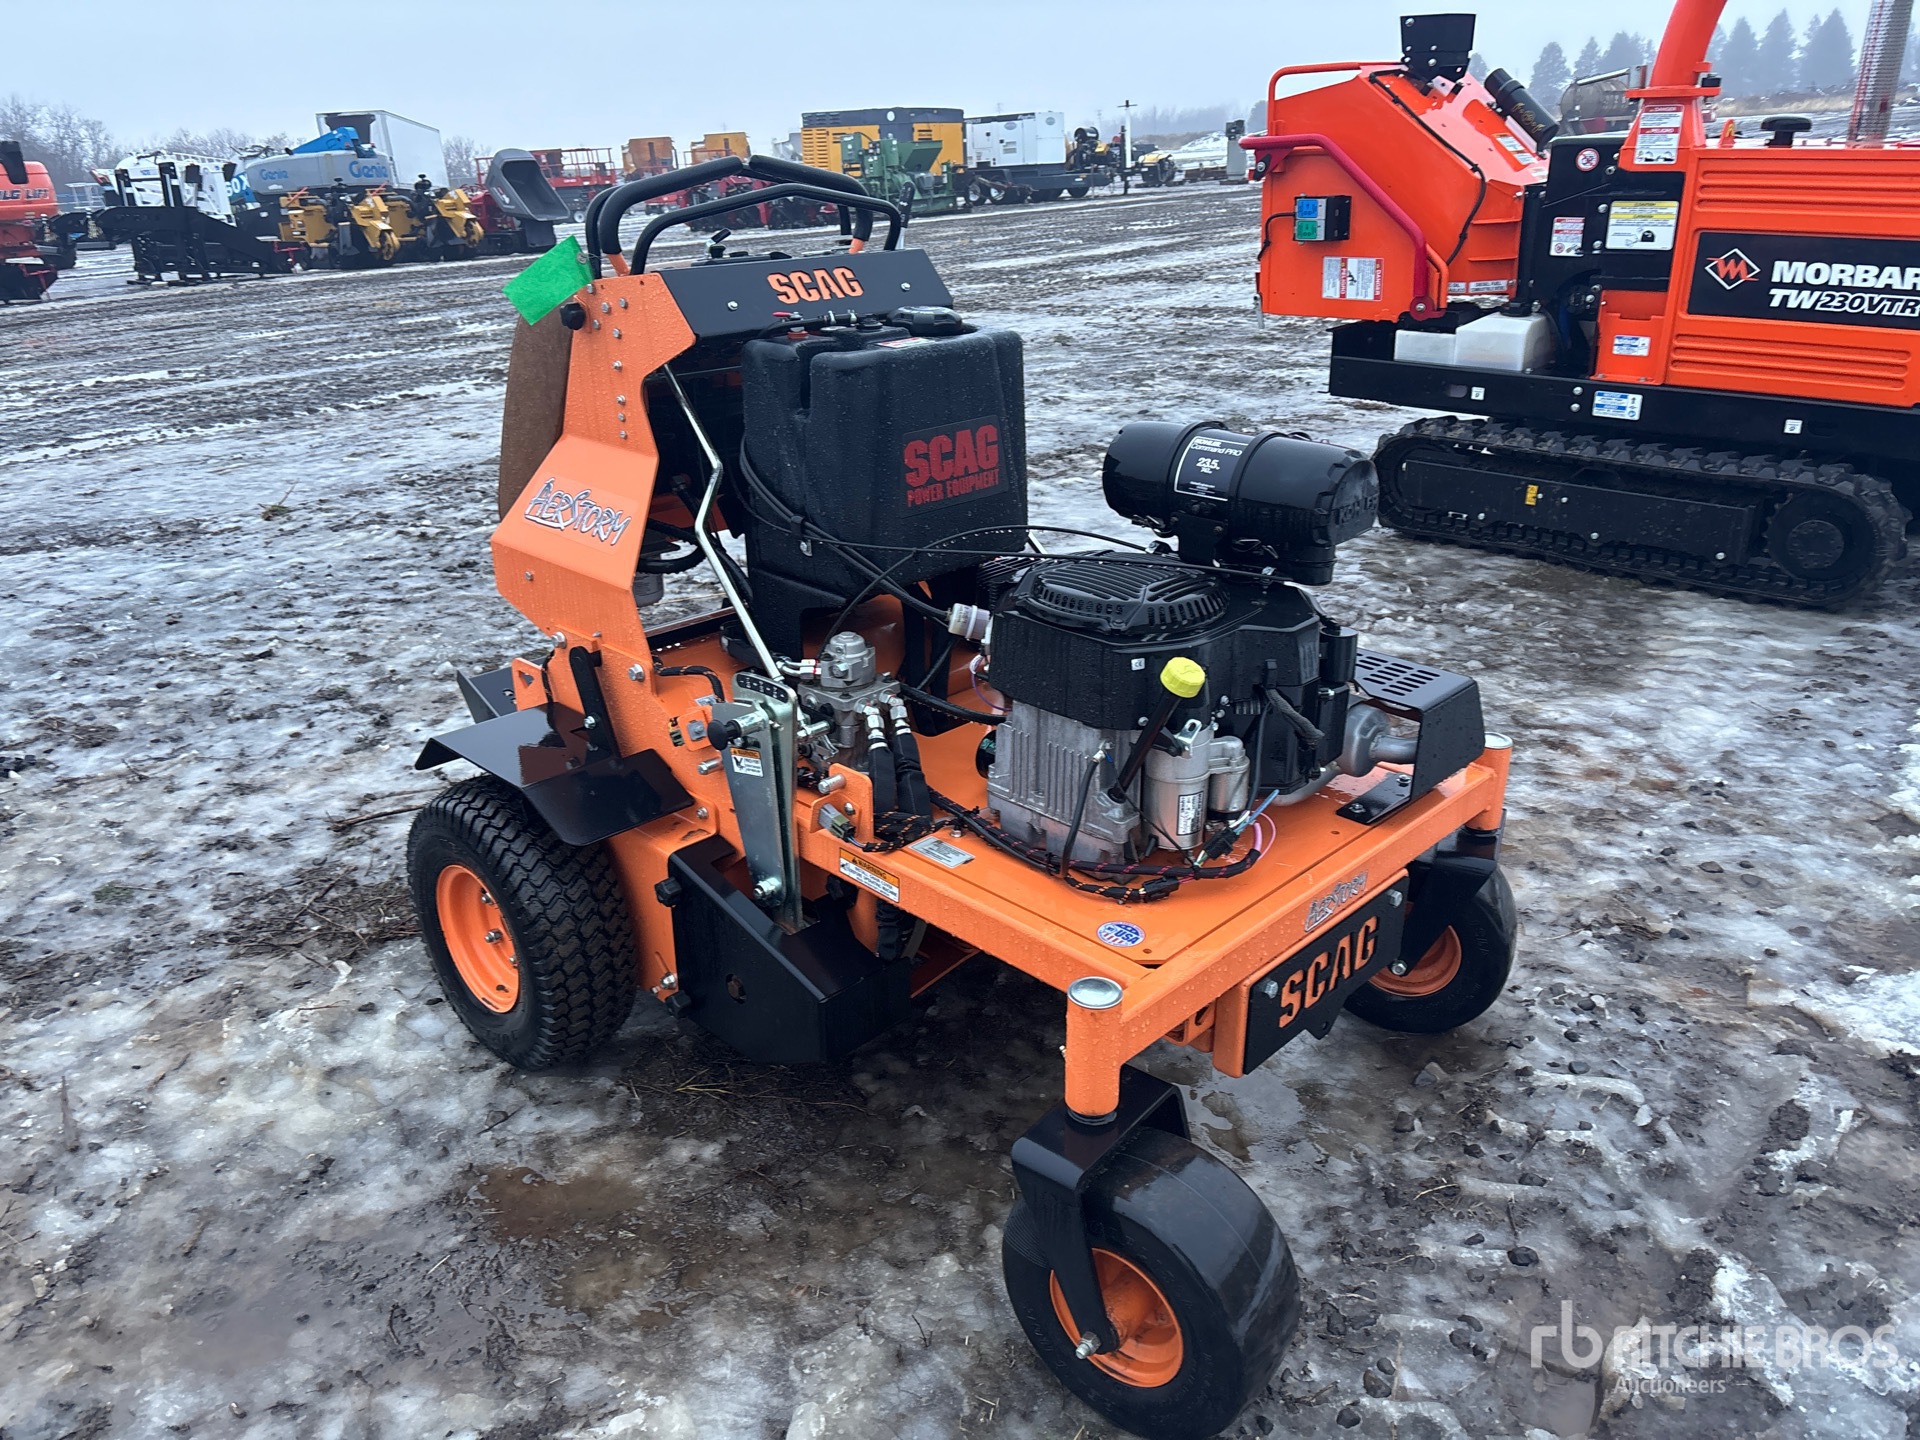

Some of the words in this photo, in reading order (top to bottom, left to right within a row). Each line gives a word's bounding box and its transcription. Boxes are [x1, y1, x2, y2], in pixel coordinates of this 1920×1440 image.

[260, 168, 289, 181] Genie
[348, 161, 388, 180] Genie
[766, 266, 864, 304] SCAG
[904, 424, 999, 487] SCAG
[1223, 447, 1243, 457] PRO
[906, 483, 944, 508] POWER
[946, 469, 1000, 498] EQUIPMENT
[1114, 929, 1141, 945] USA
[1279, 915, 1378, 1029] SCAG
